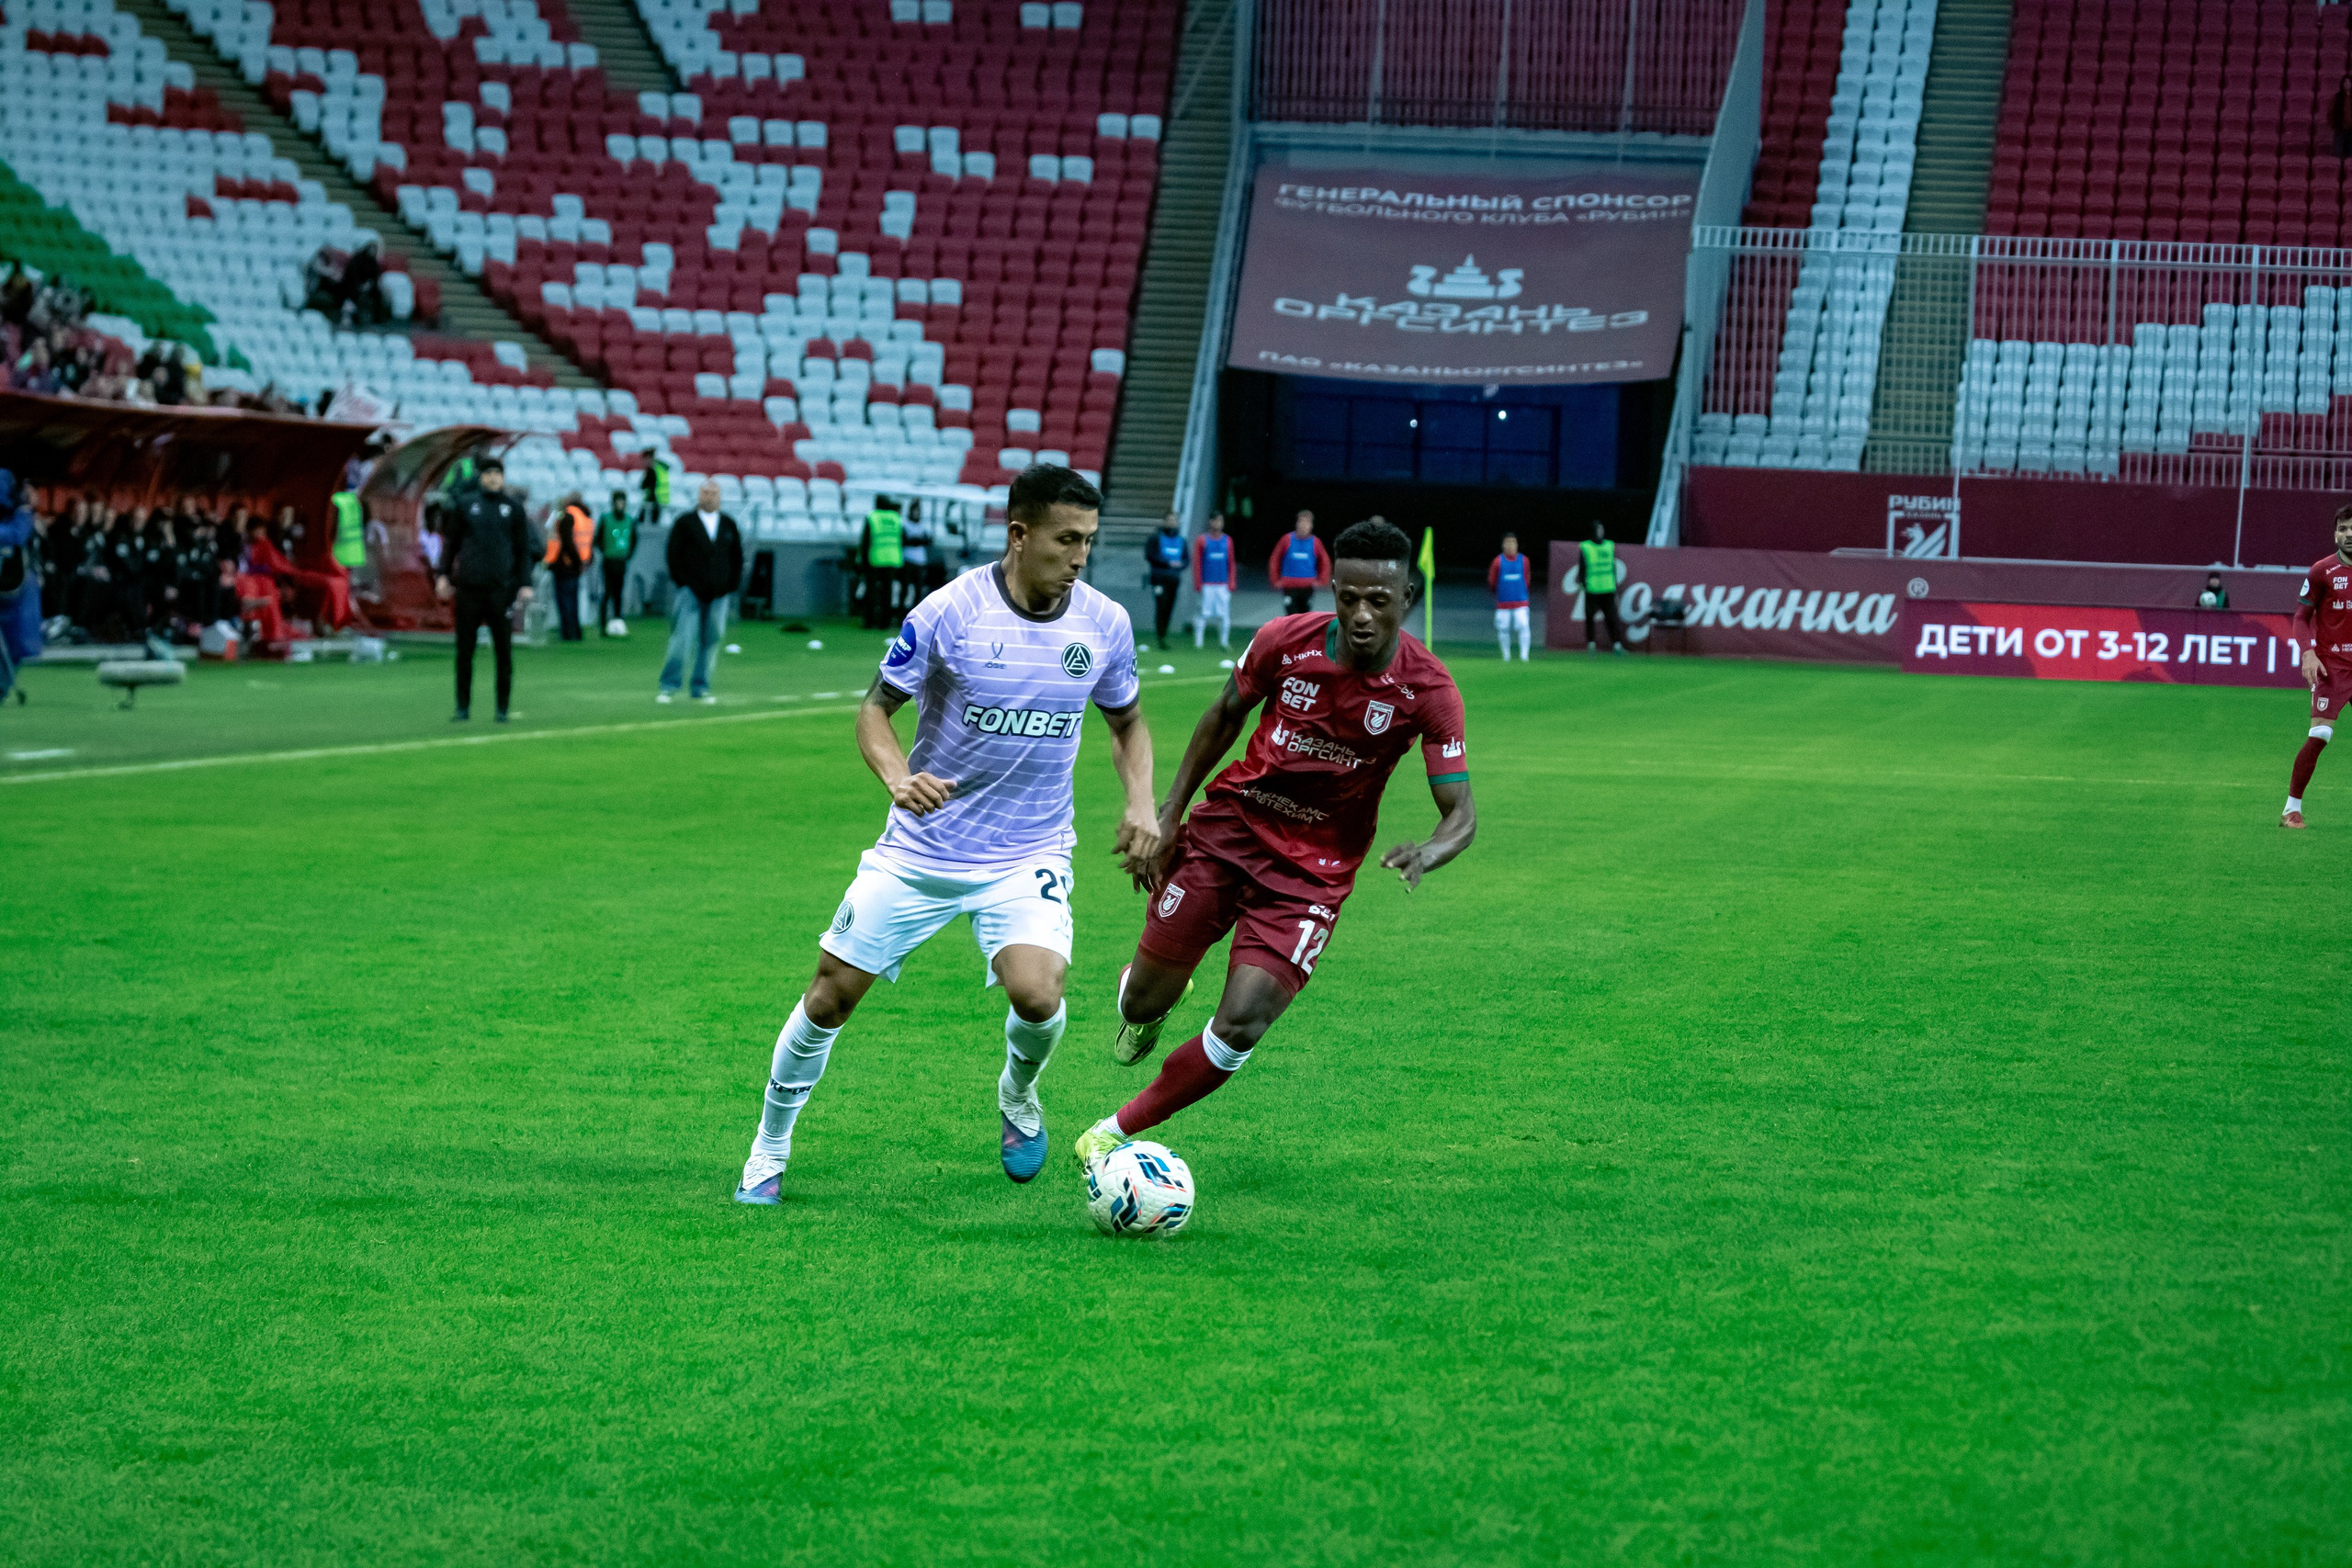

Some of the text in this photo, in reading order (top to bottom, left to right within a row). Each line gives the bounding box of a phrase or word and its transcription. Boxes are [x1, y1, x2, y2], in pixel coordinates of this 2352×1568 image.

[1278, 184, 1692, 211] ГЕНЕРАЛЬНЫЙ СПОНСОР
[1480, 210, 1569, 226] КЛУБА
[1336, 293, 1592, 321] КАЗАНЬ
[1260, 350, 1321, 367] ПАО
[1888, 494, 1961, 511] РУБИН
[1916, 624, 2022, 659] ДЕТИ
[2034, 628, 2089, 659] ОТ
[2097, 630, 2169, 661] 3-12
[2177, 634, 2256, 665] ЛЕТ
[1282, 676, 1320, 697] FON
[1281, 689, 1317, 712] BET
[962, 704, 1083, 739] FONBET
[1290, 731, 1356, 756] КАЗАНЬ
[1290, 919, 1329, 975] 12
